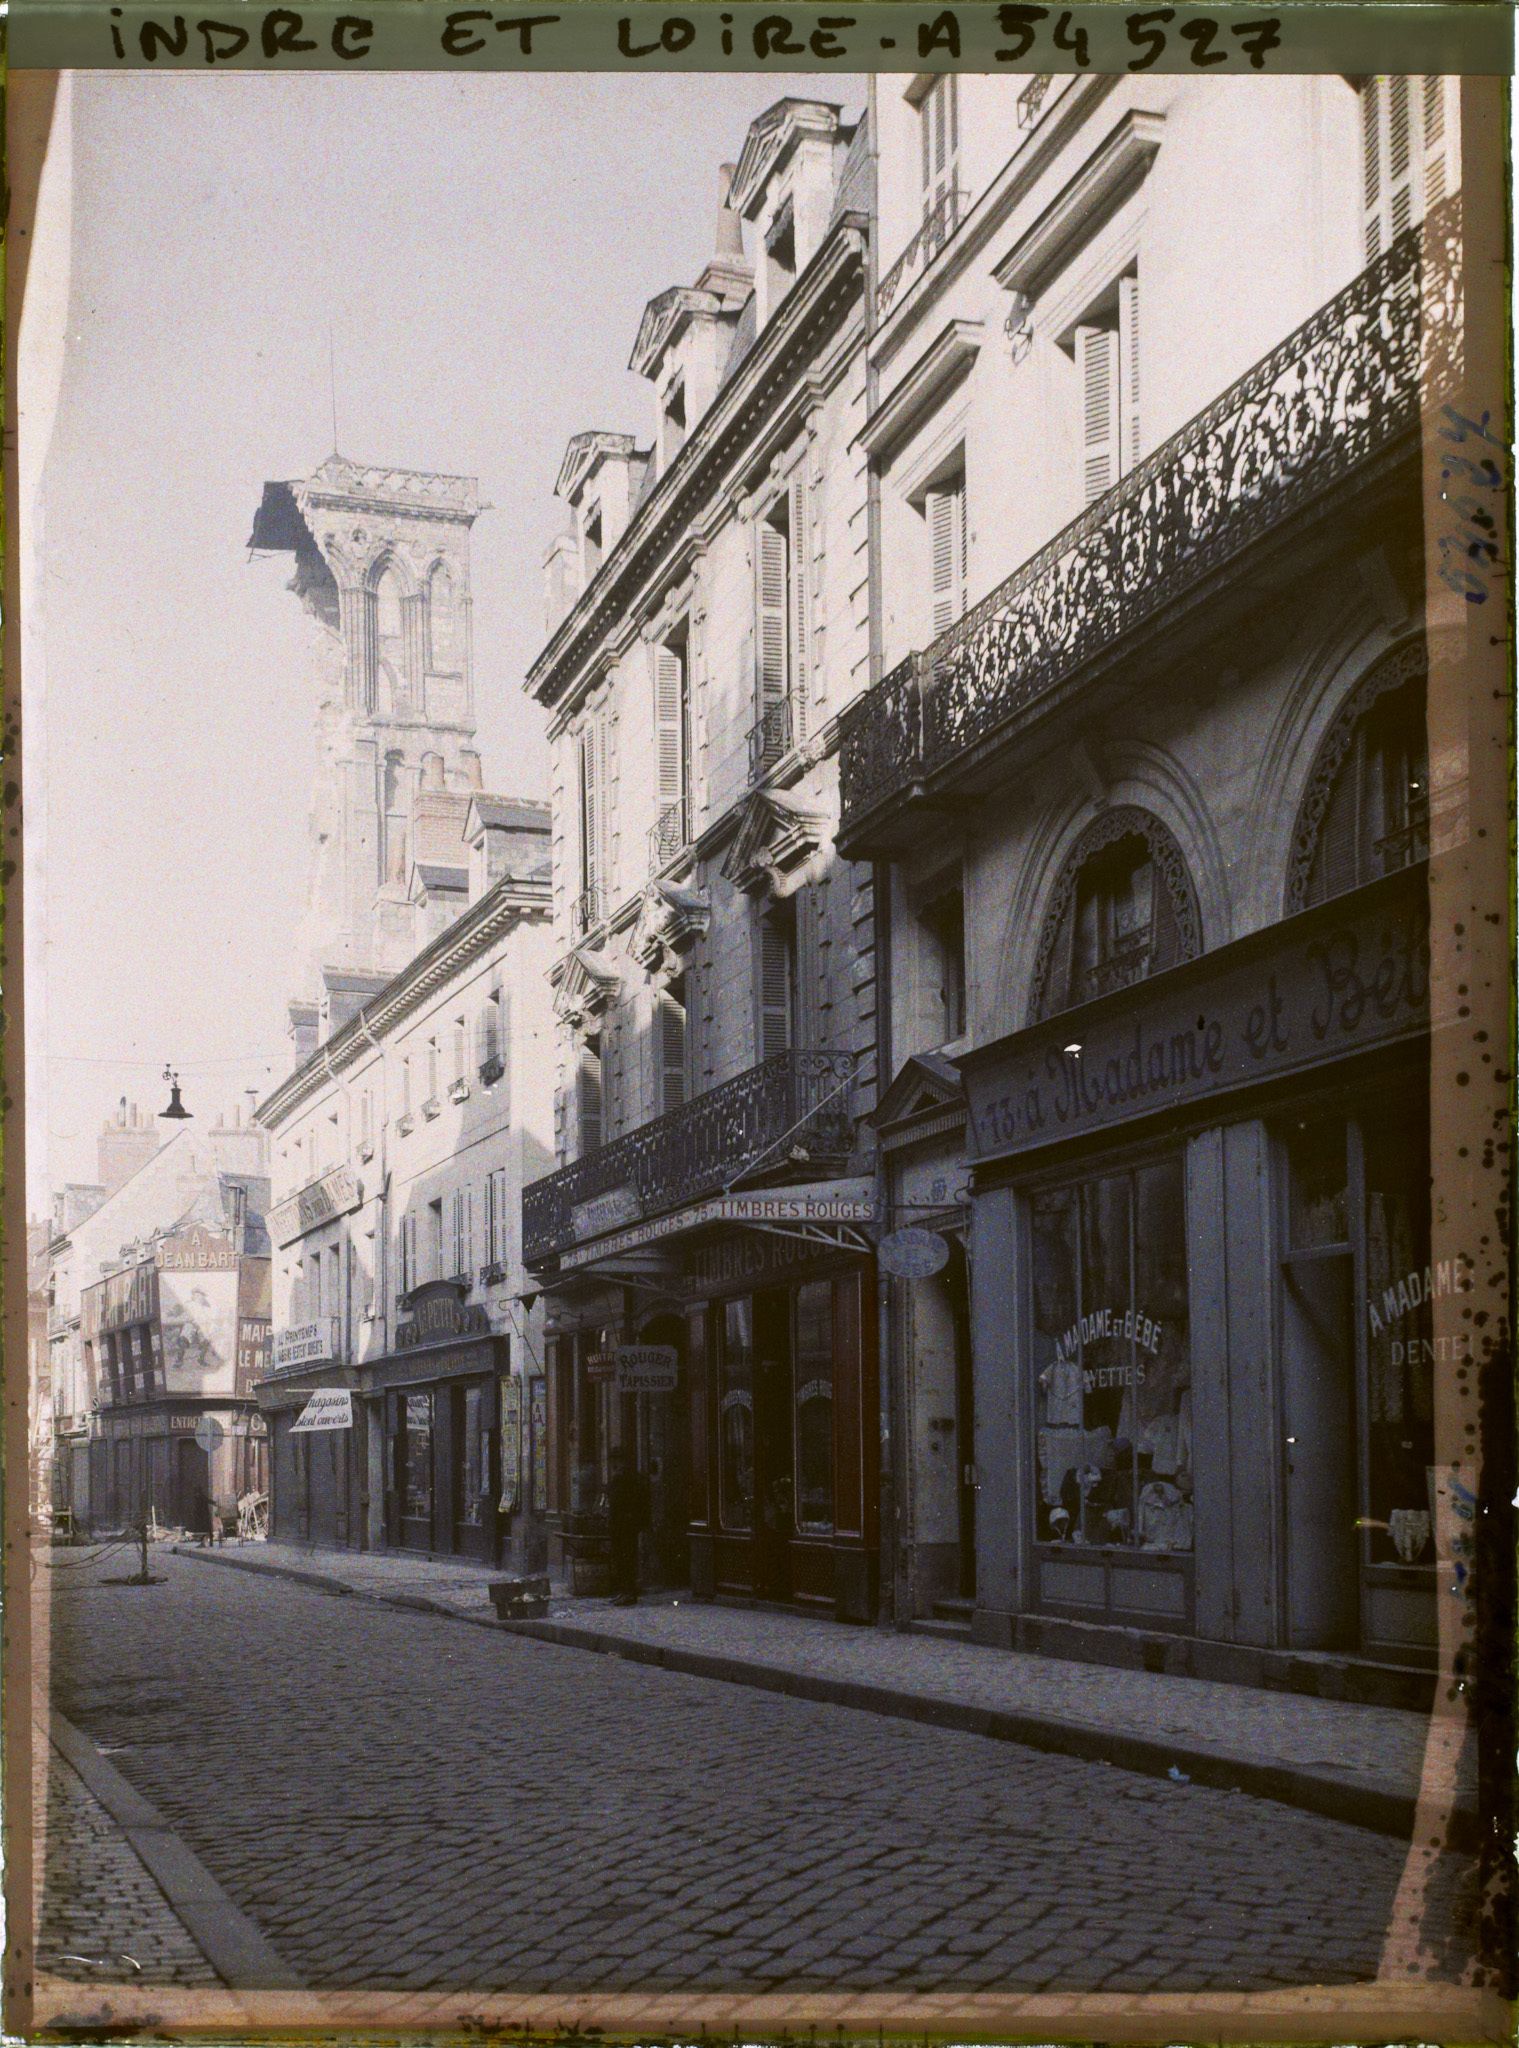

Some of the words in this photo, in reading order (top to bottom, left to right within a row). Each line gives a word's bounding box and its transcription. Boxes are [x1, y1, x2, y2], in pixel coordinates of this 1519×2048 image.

[1243, 975, 1291, 1058] et
[720, 1200, 800, 1218] TIMBRES
[806, 1203, 874, 1219] ROUGES
[637, 1216, 685, 1244] ROUGES
[156, 1252, 195, 1269] JEAN
[199, 1252, 239, 1268] BART
[1383, 1258, 1465, 1324] MADAME
[1063, 1308, 1112, 1358] MADAME
[621, 1351, 672, 1371] ROUGER
[620, 1375, 676, 1389] TAPISSIER
